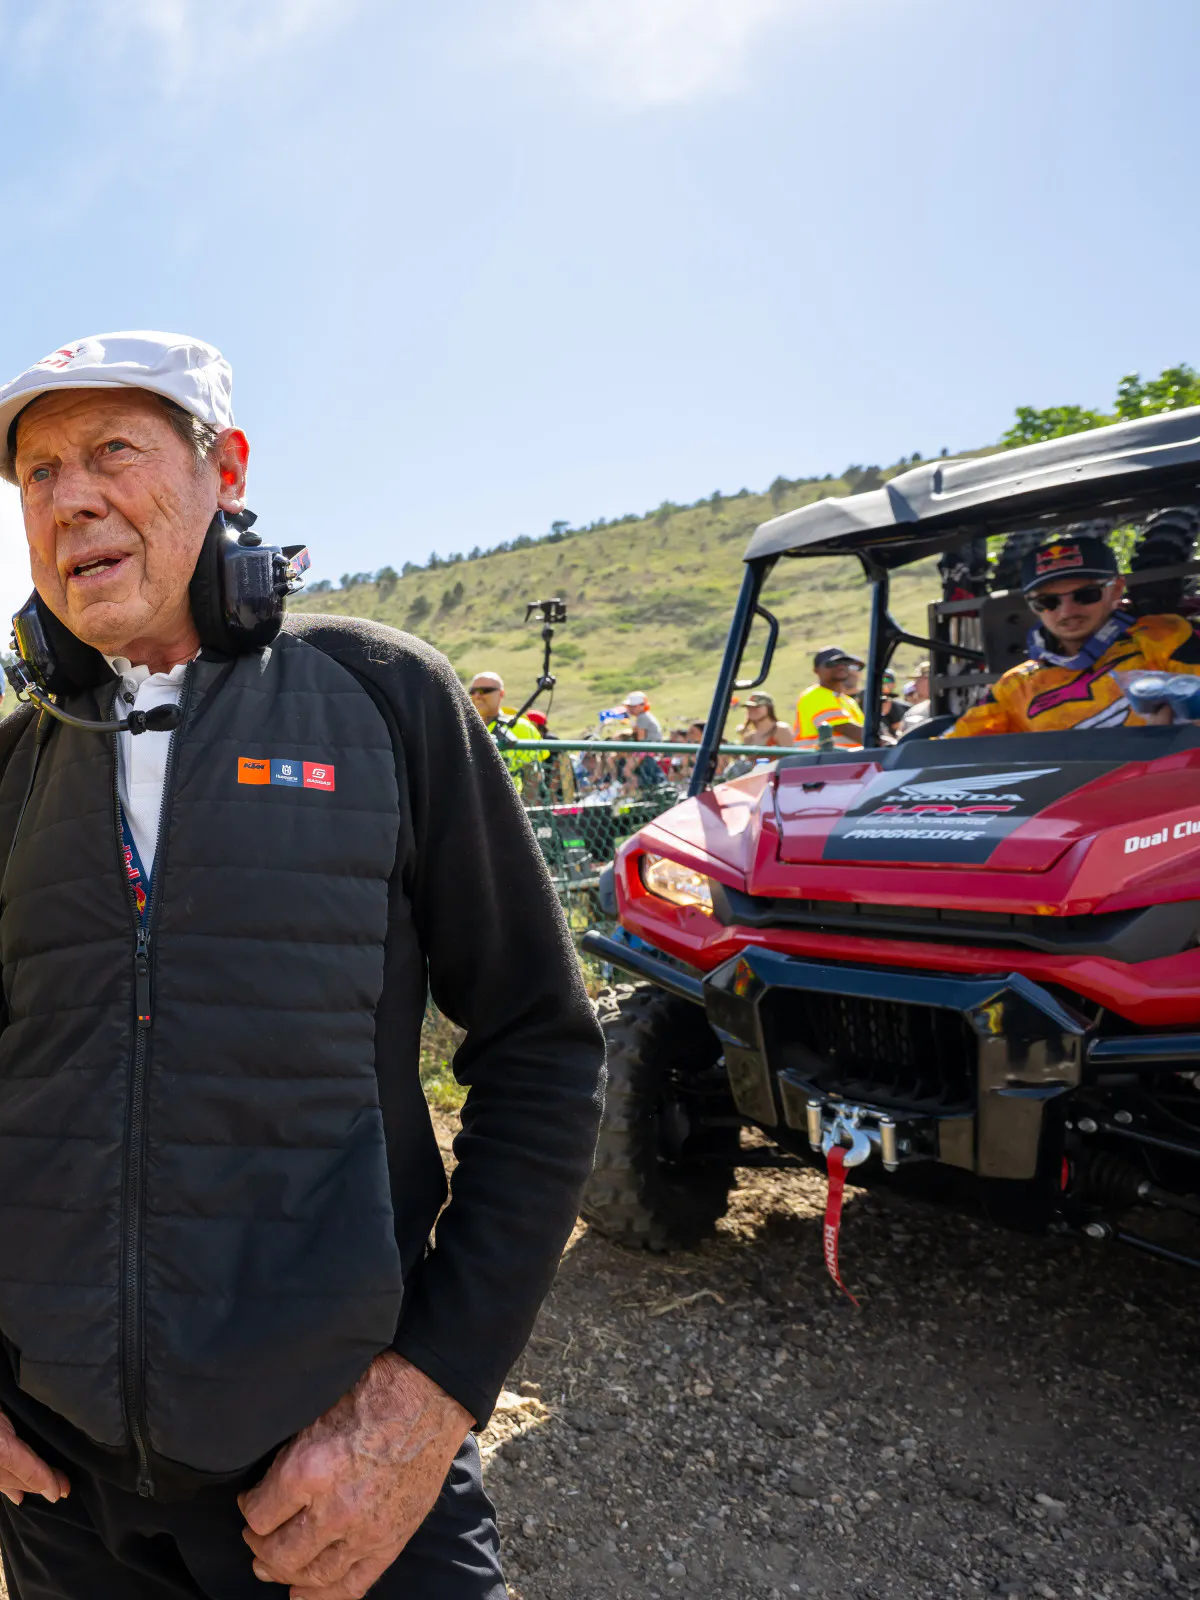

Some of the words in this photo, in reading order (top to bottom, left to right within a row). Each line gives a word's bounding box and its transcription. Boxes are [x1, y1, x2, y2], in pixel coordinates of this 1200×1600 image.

[243, 762, 265, 770] KTM
[882, 793, 1025, 802] HONDA
[842, 829, 987, 841] PROGRESSIVE
[1124, 827, 1169, 855] Dual
